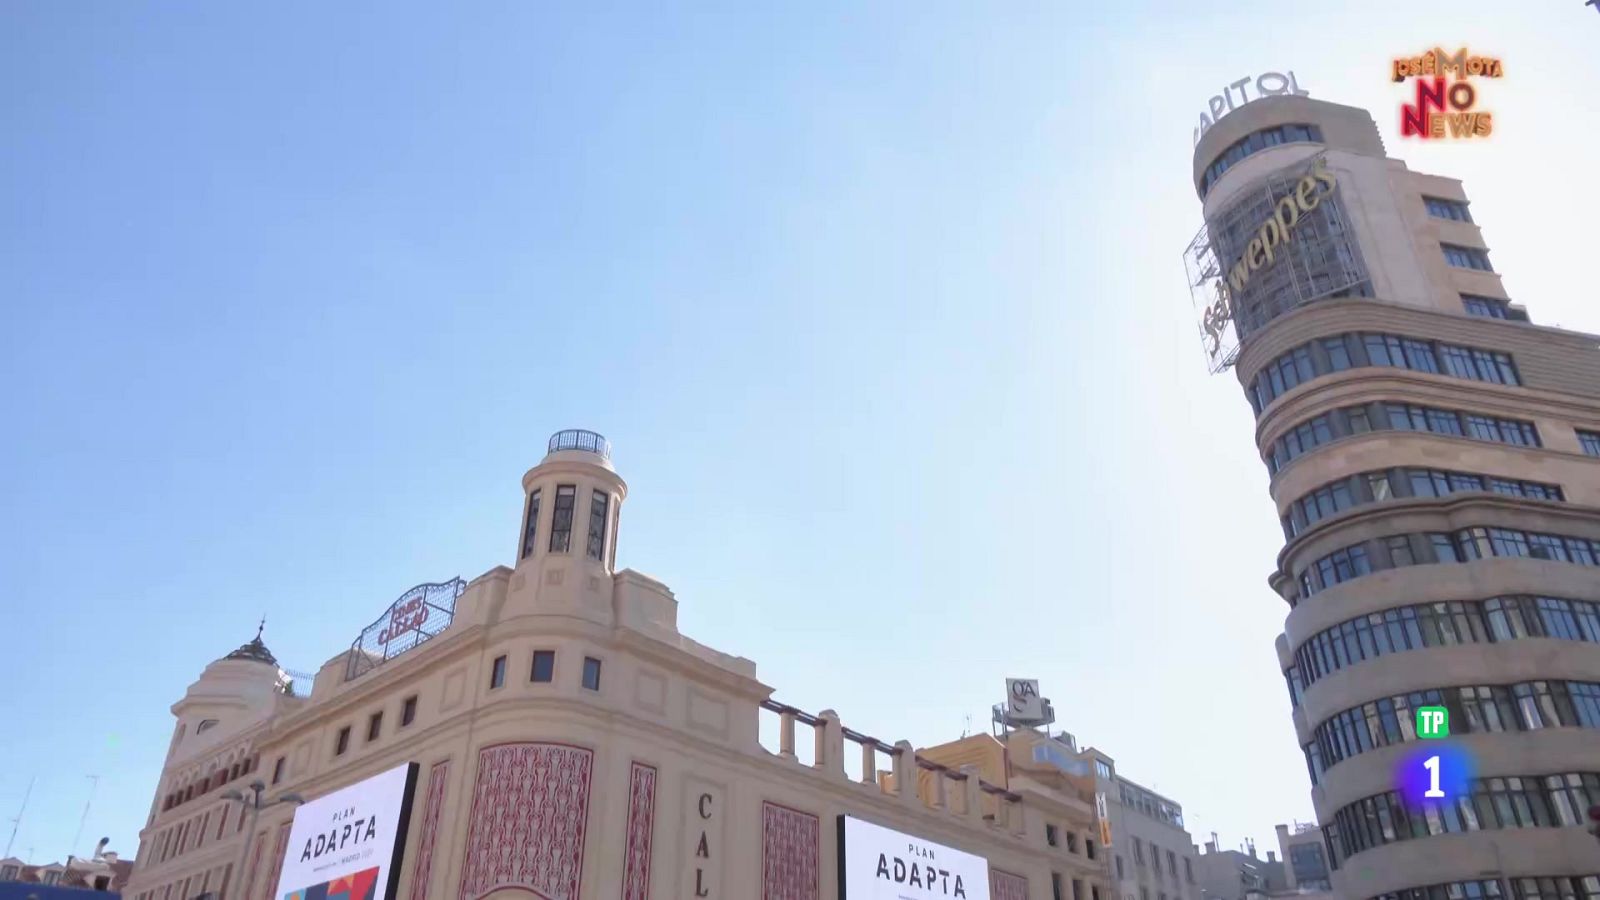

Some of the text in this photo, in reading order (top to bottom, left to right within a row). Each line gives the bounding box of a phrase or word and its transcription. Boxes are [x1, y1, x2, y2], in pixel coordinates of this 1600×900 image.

[333, 806, 356, 822] PLAN
[300, 814, 376, 863] ADAPTA
[909, 844, 935, 860] PLAN
[876, 853, 966, 899] ADAPTA
